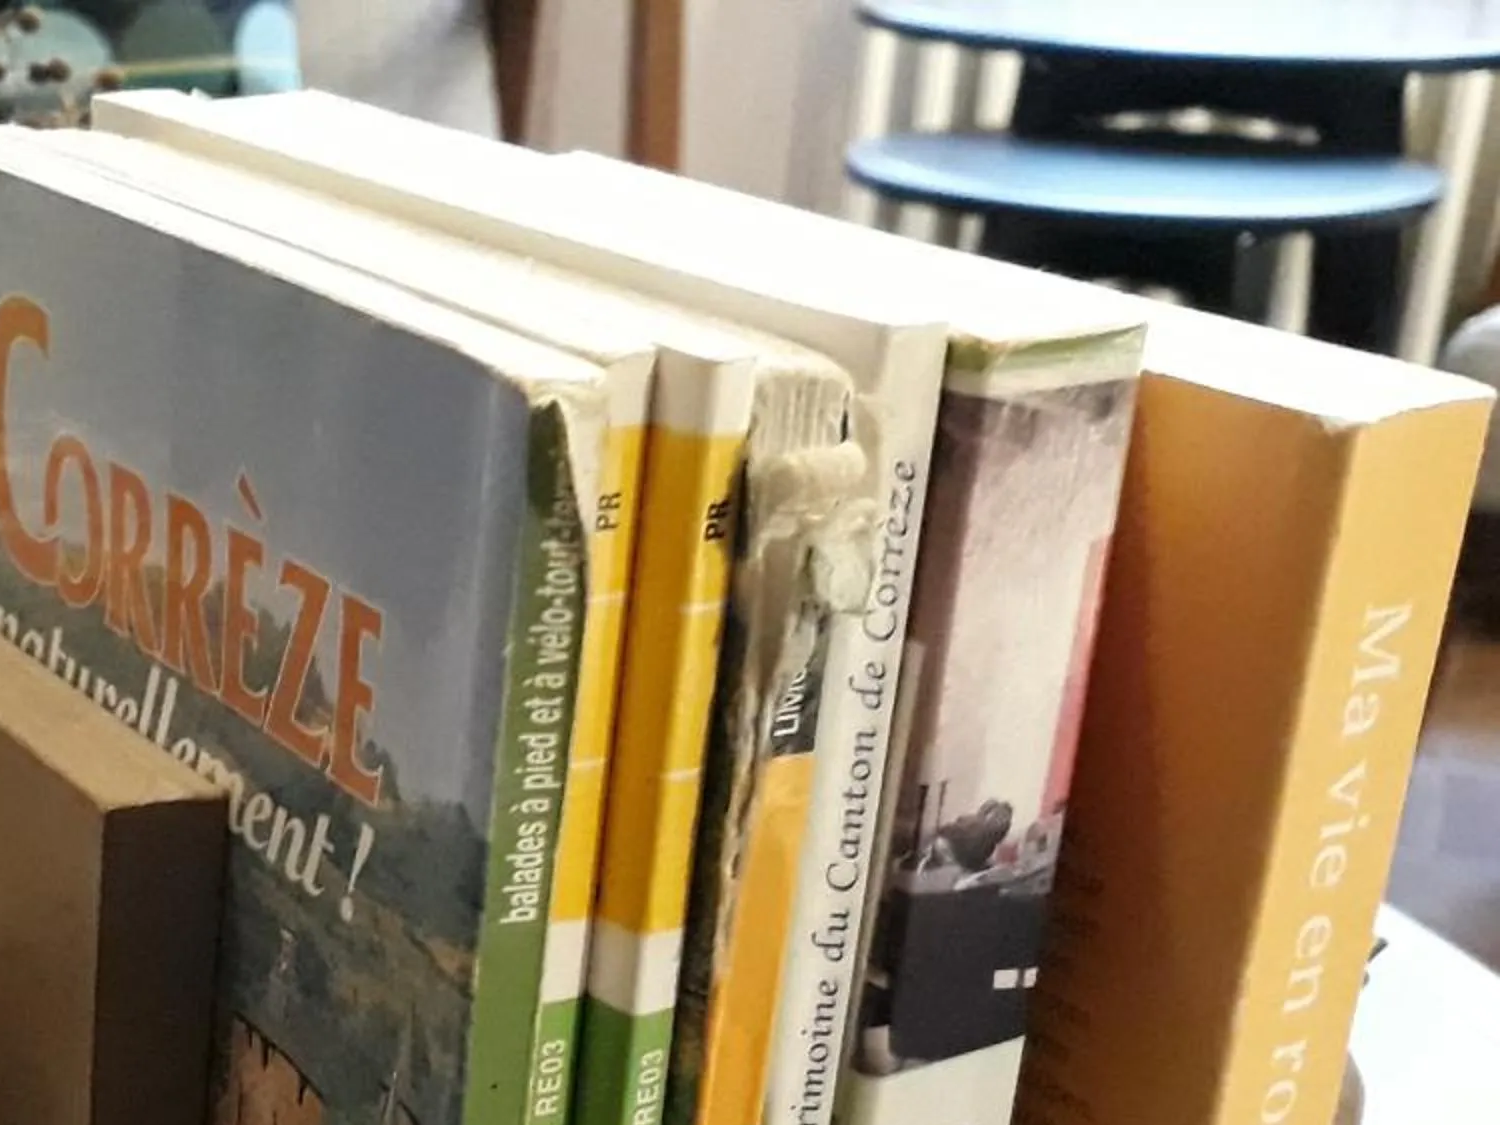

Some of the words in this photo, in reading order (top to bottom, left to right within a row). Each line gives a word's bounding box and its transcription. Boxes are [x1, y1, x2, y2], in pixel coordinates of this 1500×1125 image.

[597, 491, 621, 531] PR
[705, 500, 731, 542] PR
[523, 672, 568, 689] à
[849, 661, 886, 710] de
[1342, 599, 1413, 742] Ma
[524, 696, 565, 725] et
[515, 732, 563, 790] pied
[510, 796, 552, 813] à
[826, 728, 877, 892] Canton
[1309, 763, 1369, 890] vie
[500, 820, 547, 924] balades
[812, 910, 850, 962] du
[1282, 912, 1333, 1014] en
[534, 1039, 566, 1117] RE03
